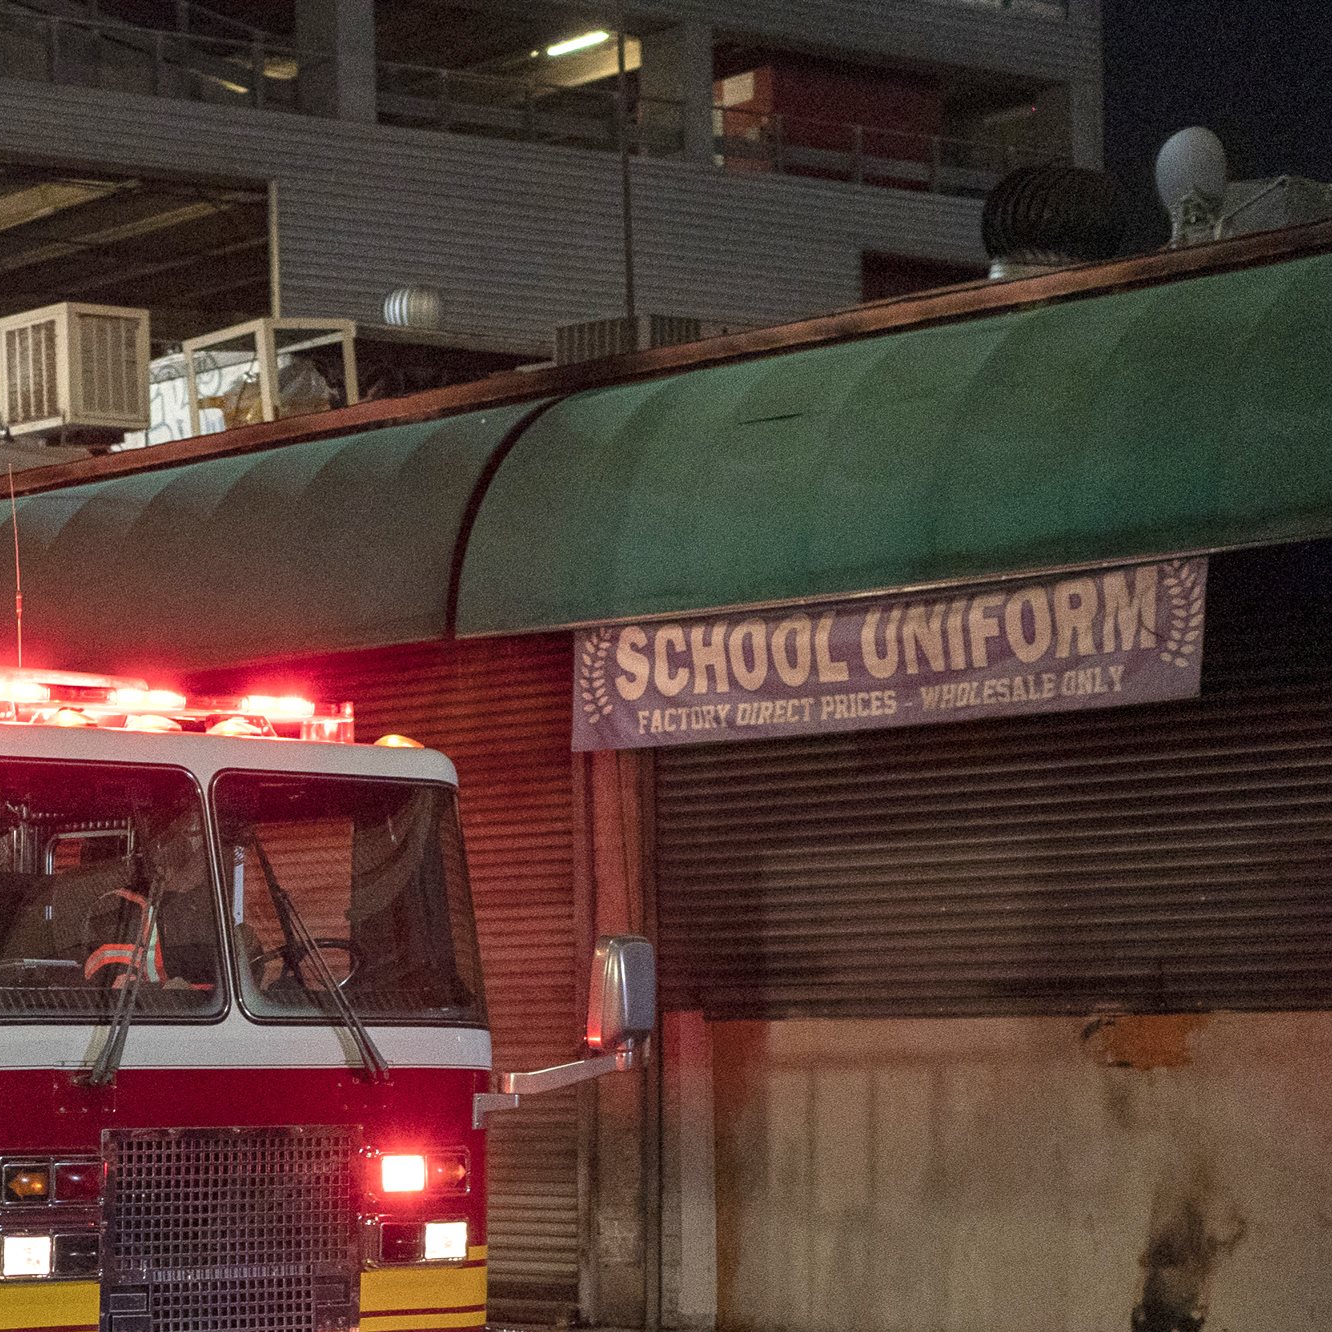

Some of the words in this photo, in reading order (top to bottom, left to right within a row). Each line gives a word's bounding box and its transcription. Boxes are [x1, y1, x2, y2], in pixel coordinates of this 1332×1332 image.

[615, 611, 849, 700] SCHOOL
[861, 567, 1156, 678] UNIFORM
[638, 703, 731, 734] FACTORY
[737, 697, 813, 726] DIRECT
[820, 690, 897, 720] PRICES
[921, 673, 1056, 711] WHOLESALE
[1063, 665, 1125, 697] ONLY
